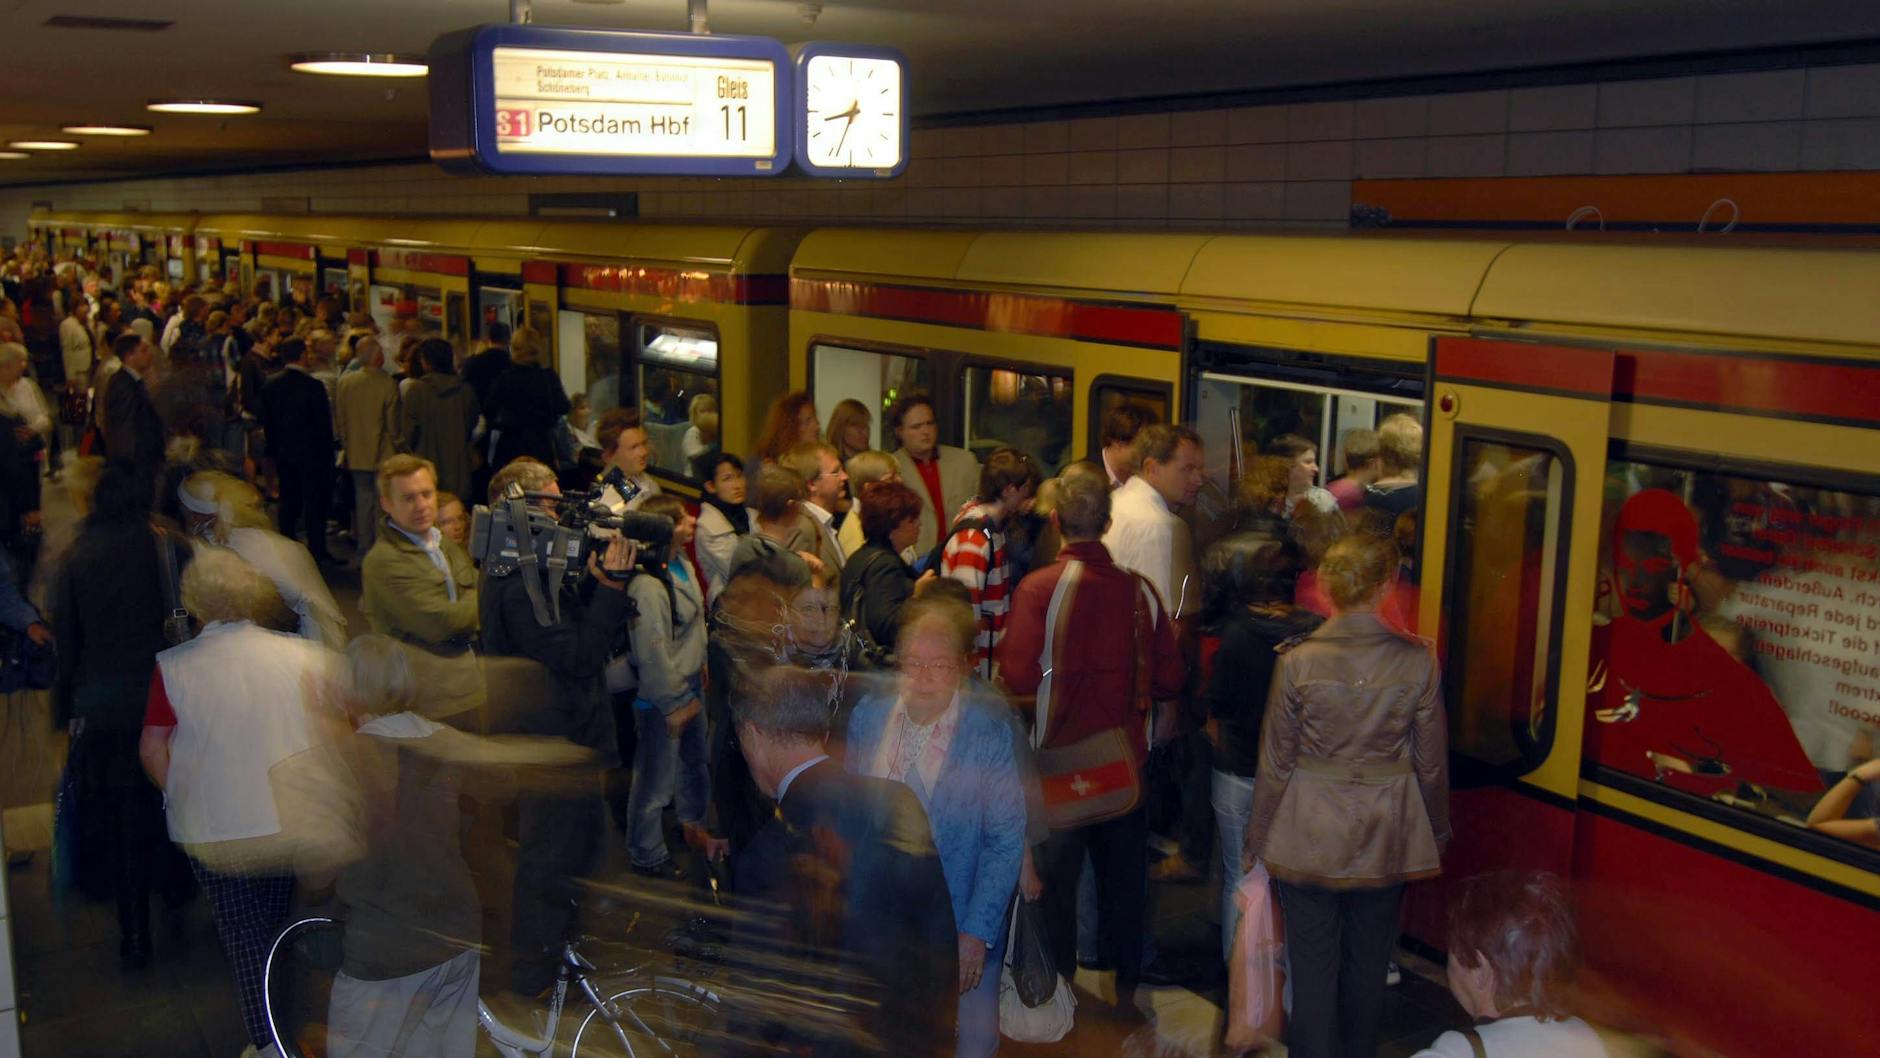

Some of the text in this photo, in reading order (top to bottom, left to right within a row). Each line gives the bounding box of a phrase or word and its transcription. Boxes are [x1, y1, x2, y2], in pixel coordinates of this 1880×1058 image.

[717, 75, 749, 99] Gleis
[538, 112, 641, 134] Potsdam
[651, 115, 690, 135] Hbf
[720, 104, 747, 141] 11
